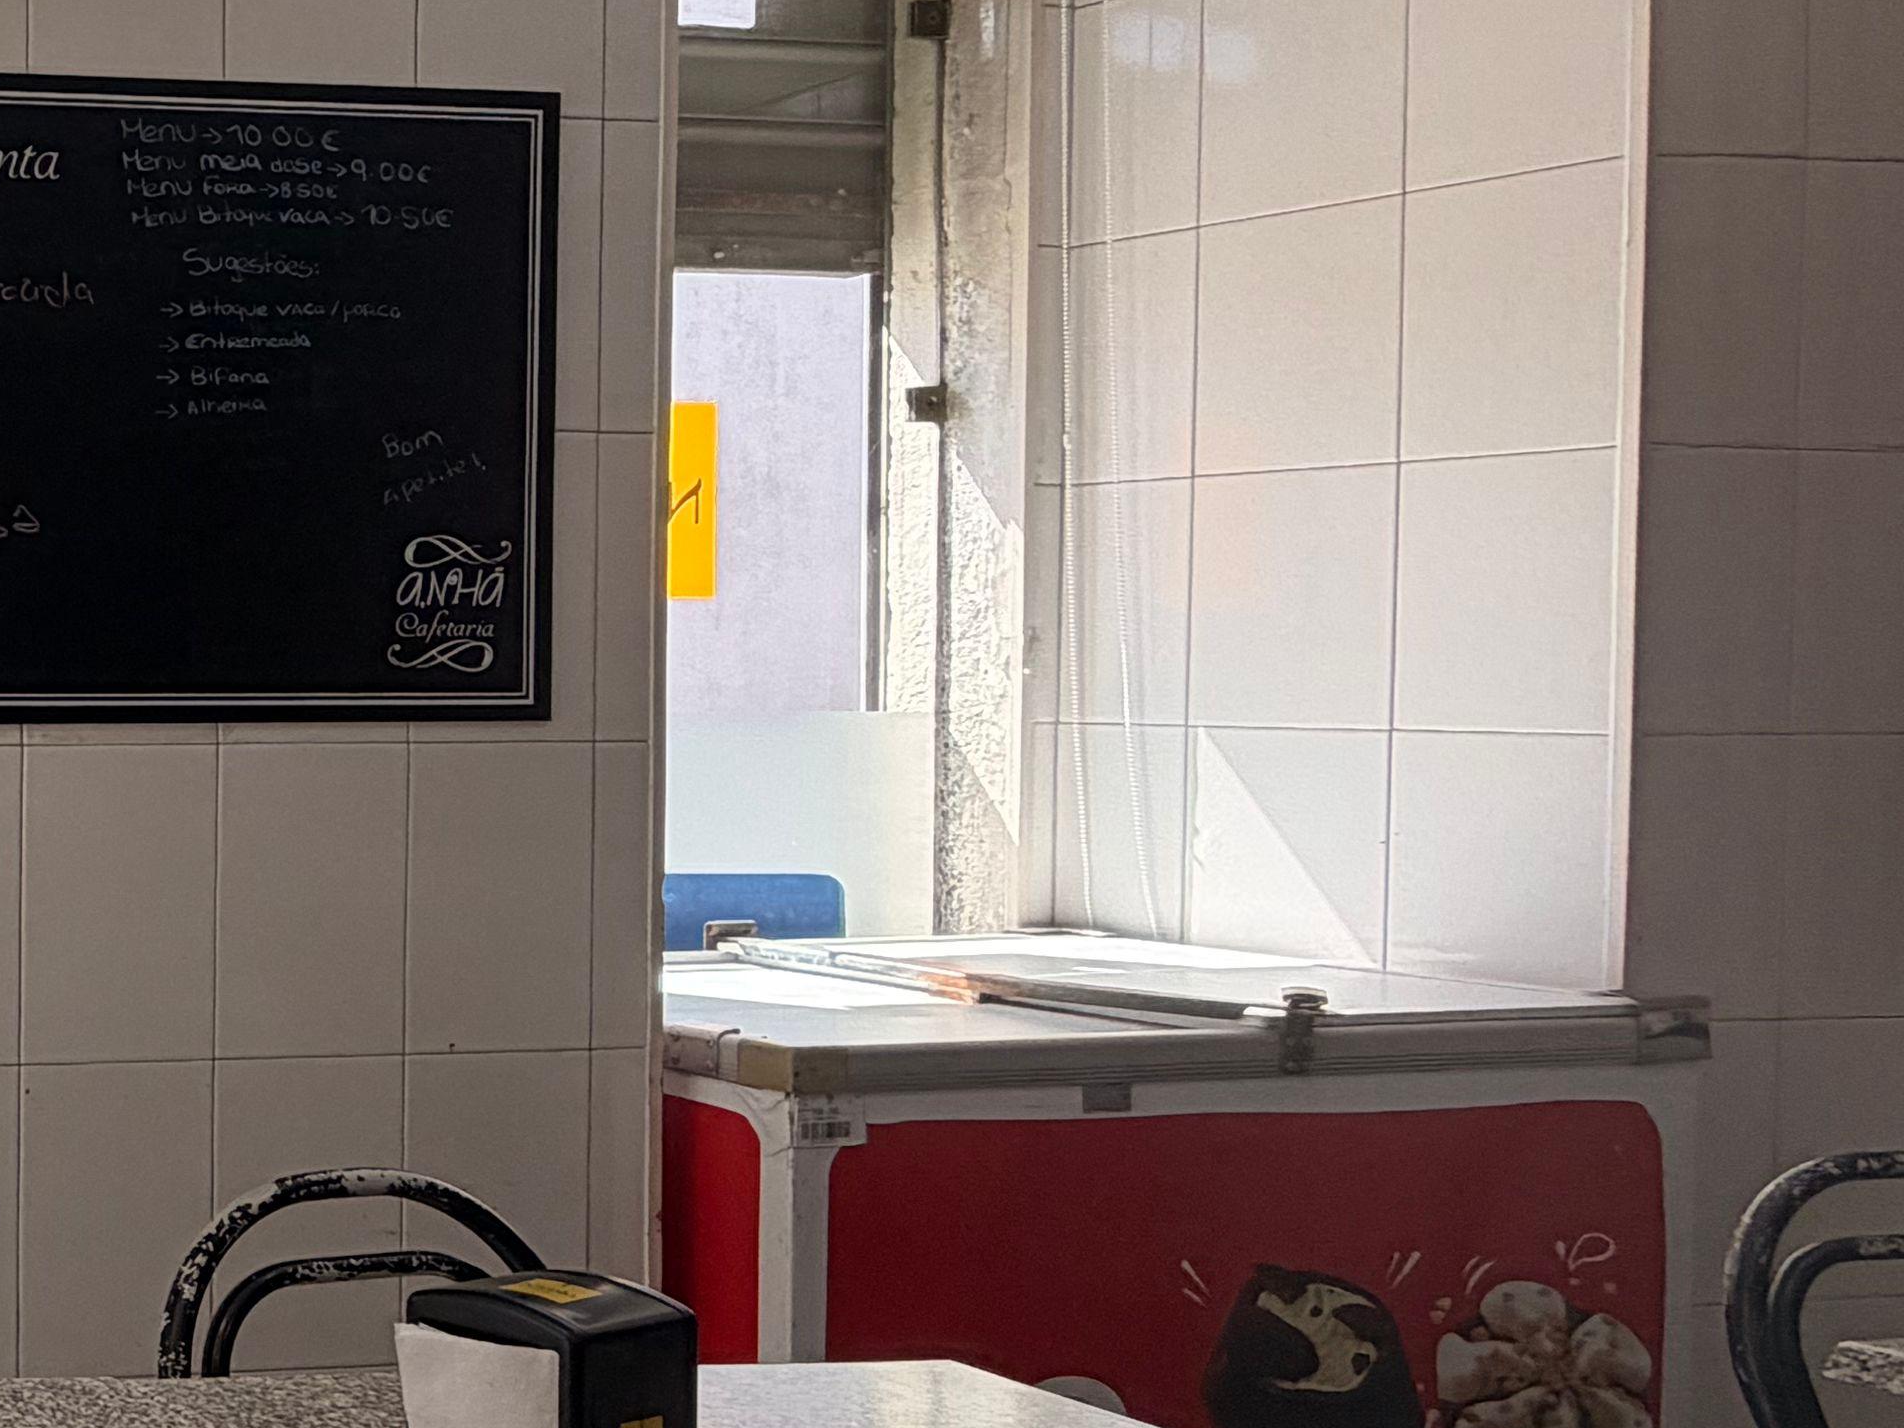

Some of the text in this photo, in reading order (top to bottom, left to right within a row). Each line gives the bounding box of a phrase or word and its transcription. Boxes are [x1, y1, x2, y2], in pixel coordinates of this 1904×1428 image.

[119, 117, 195, 144] Menu
[121, 147, 187, 173] Menu
[127, 176, 192, 198] Menu
[131, 205, 187, 228] Menu
[188, 295, 270, 324] Bitoque
[189, 365, 271, 387] Bifana
[381, 429, 444, 459] Bom
[394, 608, 496, 644] Cafetaria
